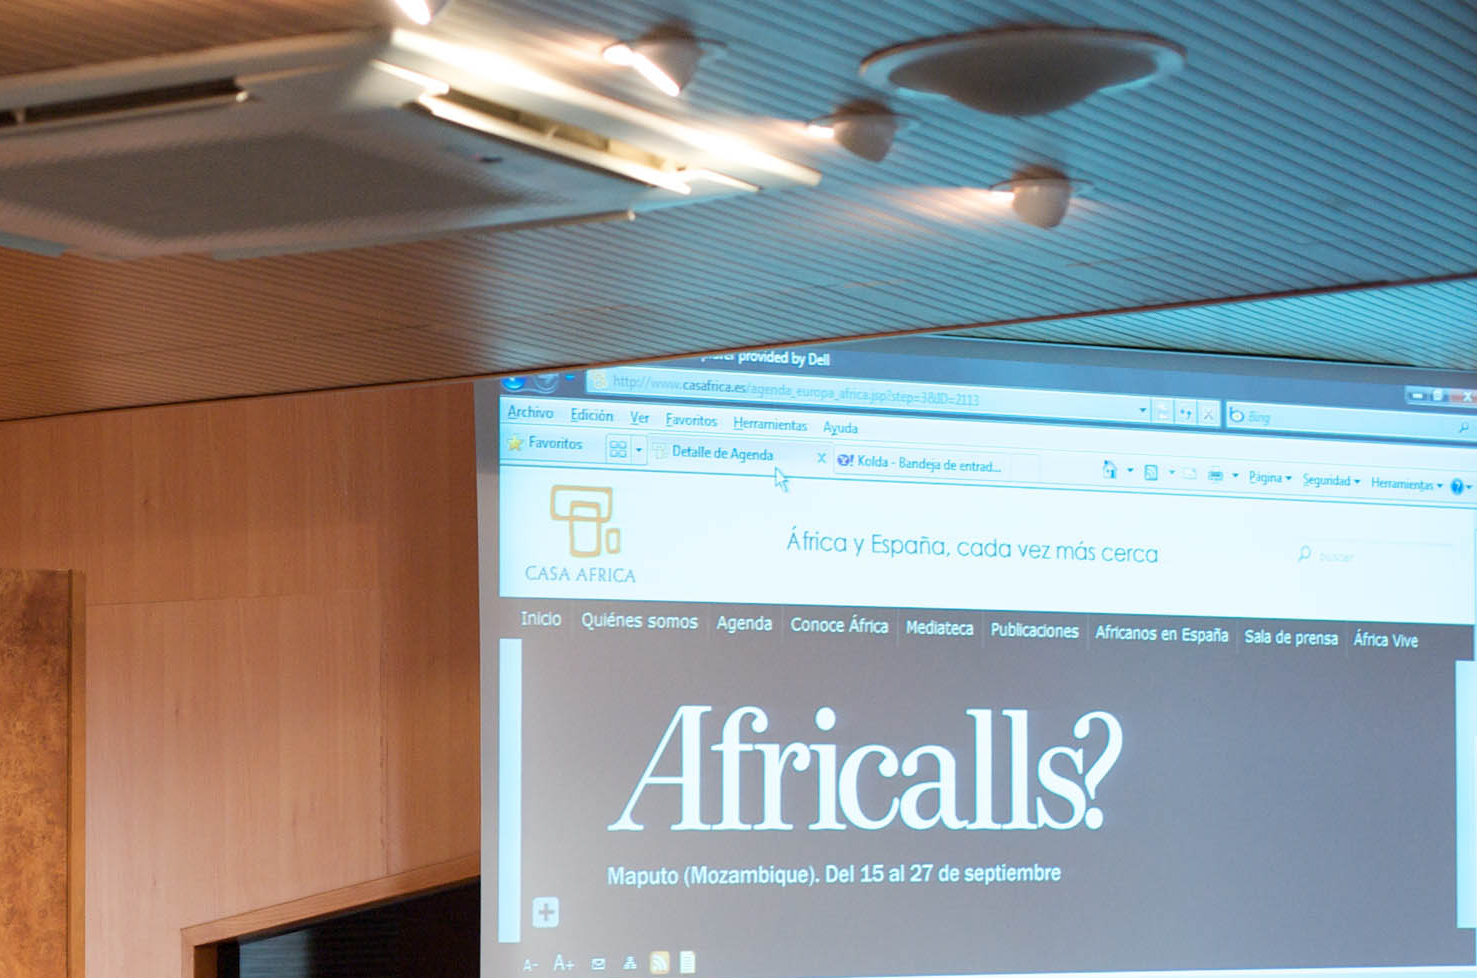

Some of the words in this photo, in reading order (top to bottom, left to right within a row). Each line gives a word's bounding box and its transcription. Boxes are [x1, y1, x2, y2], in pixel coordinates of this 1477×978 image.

[738, 351, 788, 365] provided
[791, 352, 805, 368] by
[808, 352, 830, 366] Dell
[508, 404, 554, 422] Archivo
[570, 407, 614, 425] Edición
[629, 410, 649, 426] Ver
[665, 411, 717, 429] Favoritos
[733, 415, 807, 433] Herramientas
[823, 420, 858, 437] Ayuda
[528, 435, 583, 452] Favoritos
[672, 444, 711, 460] Detalle
[714, 446, 728, 460] de
[730, 447, 773, 464] Agenda
[857, 454, 888, 470] Kolda
[899, 456, 940, 474] Bandeja
[943, 458, 957, 472] de
[1249, 470, 1282, 487] Página
[1302, 472, 1351, 489] Seguridad
[1371, 477, 1434, 493] Herramientas
[787, 526, 848, 553] África
[851, 537, 864, 556] y
[872, 533, 951, 560] España,
[956, 538, 1012, 559] cada
[1018, 543, 1051, 561] vez
[1056, 540, 1096, 562] más
[1101, 545, 1159, 564] cerca
[525, 565, 571, 583] CASA
[576, 567, 637, 584] AFRICA
[521, 610, 562, 627] Inicio
[581, 611, 643, 631] Quiénes
[647, 617, 699, 631] somos
[716, 615, 773, 634] Agenda
[790, 617, 845, 634] Conoce
[848, 613, 890, 636] África
[906, 619, 974, 638] Mediateca
[991, 622, 1080, 639] Publicaciones
[1095, 624, 1158, 642] Africanos
[1161, 628, 1178, 642] en
[1181, 625, 1230, 646] España
[1244, 628, 1270, 645] Sala
[1274, 630, 1292, 646] de
[1295, 632, 1339, 650] prensa
[1353, 628, 1390, 649] África
[1393, 633, 1419, 649] Vive
[607, 704, 1124, 831] Africalls?
[607, 865, 679, 889] Maputo
[684, 864, 821, 889] (Mozambique).
[825, 864, 855, 884] Del
[860, 863, 884, 883] 15
[889, 863, 906, 883] al
[909, 863, 934, 883] 27
[938, 863, 960, 883] de
[964, 862, 1062, 887] septiembre
